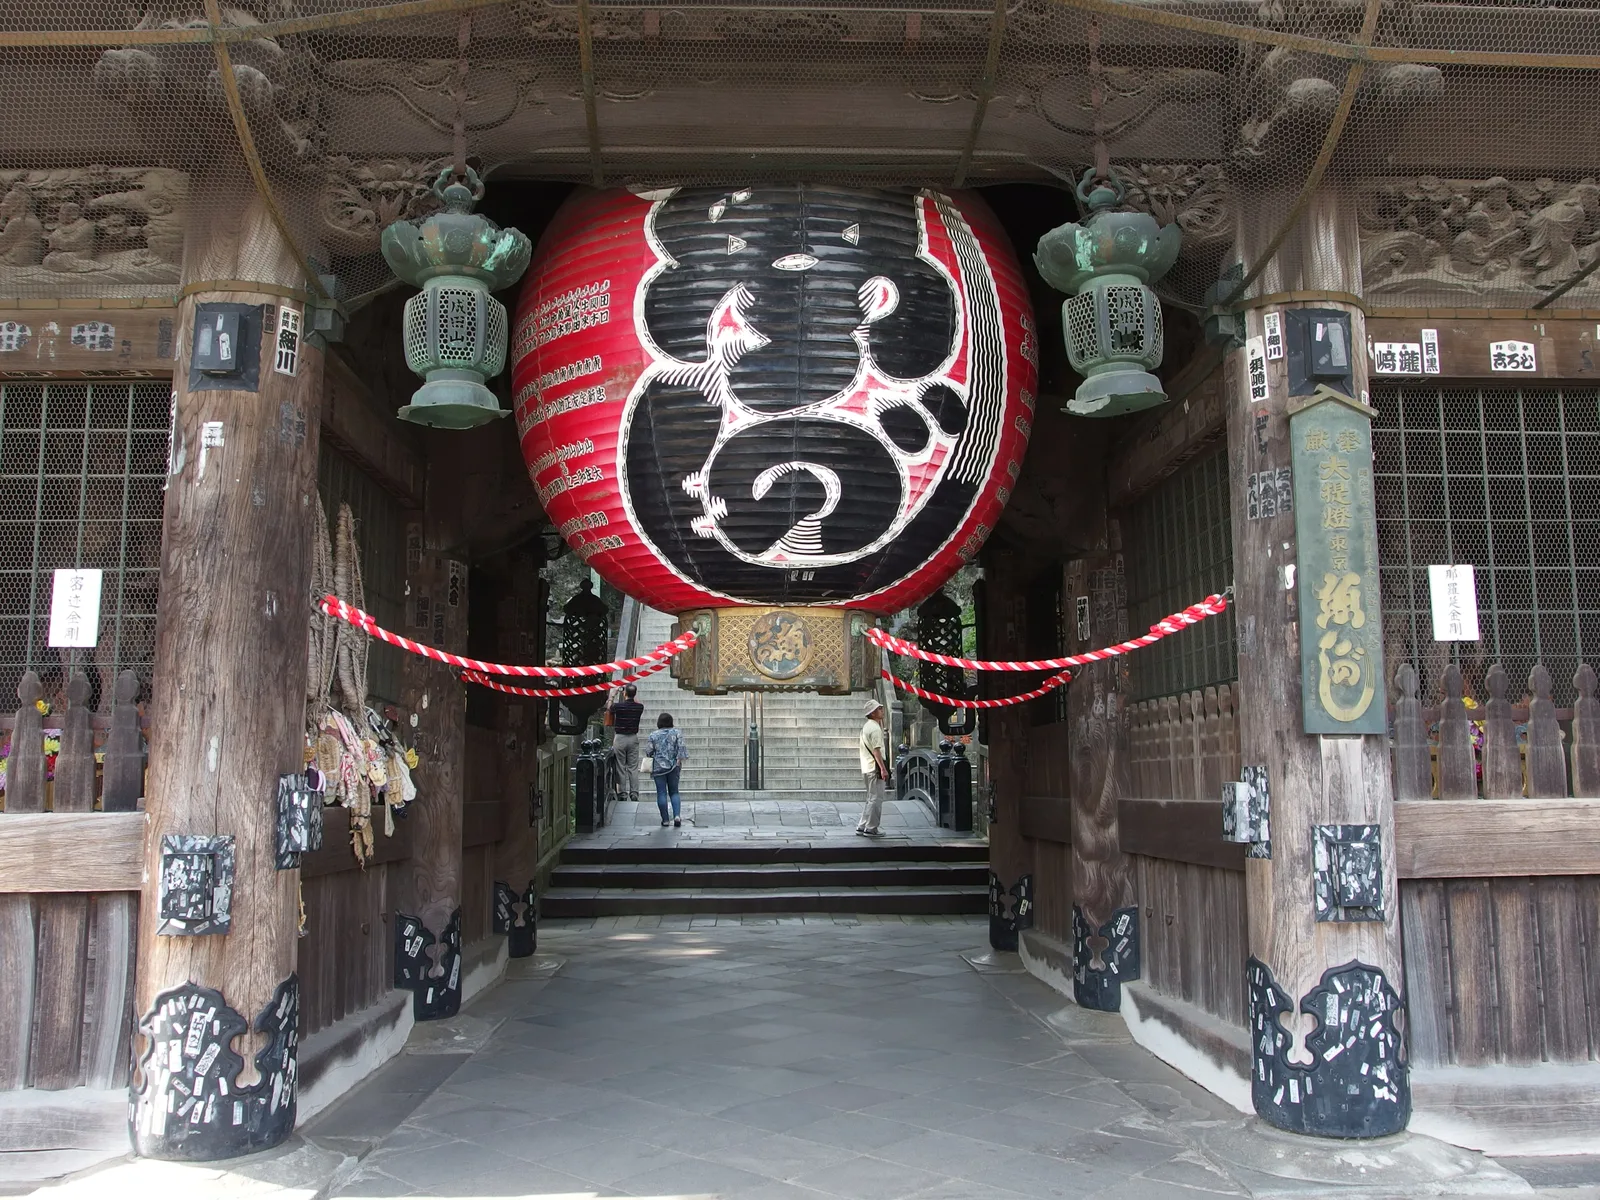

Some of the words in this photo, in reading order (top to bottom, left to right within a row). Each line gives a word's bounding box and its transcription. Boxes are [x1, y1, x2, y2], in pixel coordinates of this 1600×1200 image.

[450, 299, 466, 343] 成田山
[1329, 535, 1349, 571] 東京
